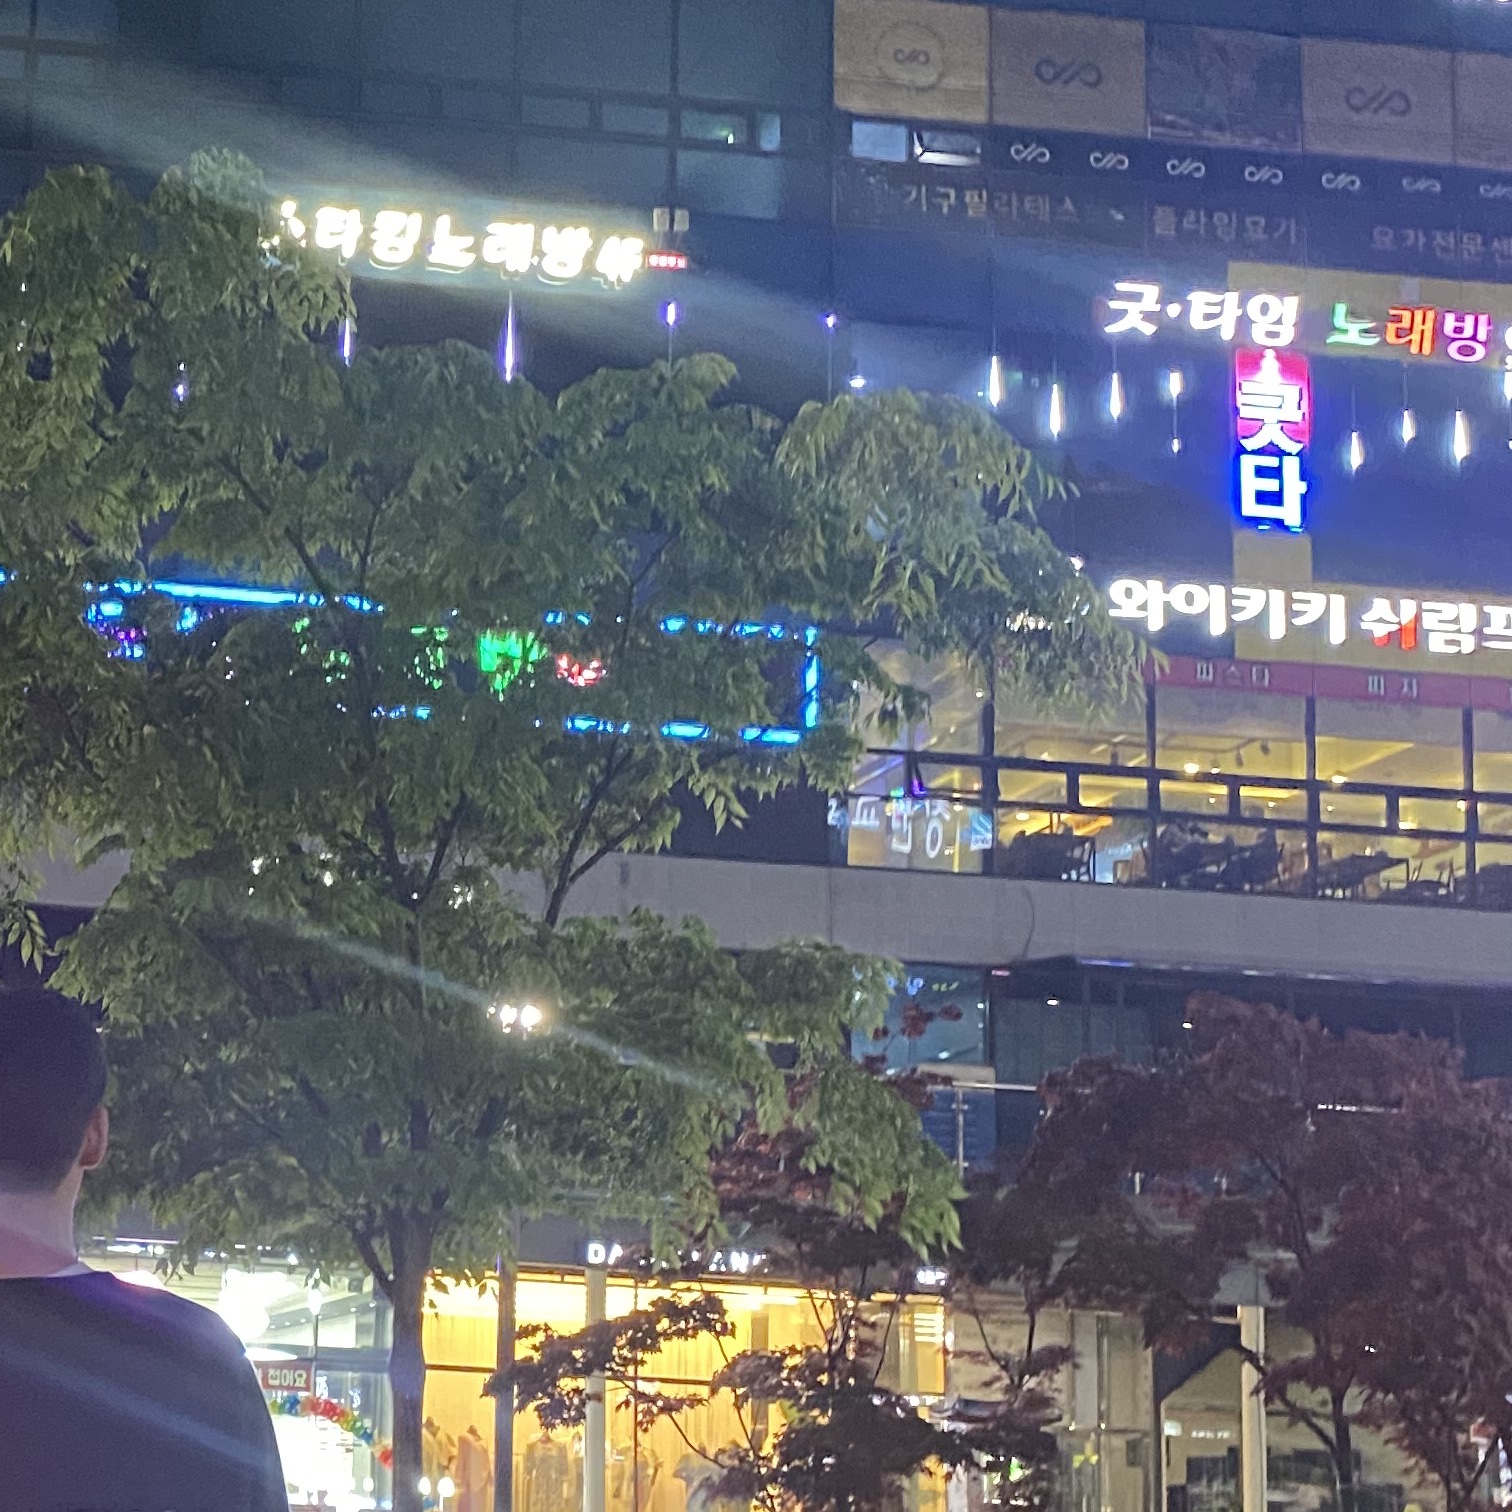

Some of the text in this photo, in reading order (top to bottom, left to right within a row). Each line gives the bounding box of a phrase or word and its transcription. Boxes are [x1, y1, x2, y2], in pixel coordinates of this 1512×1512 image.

[262, 200, 591, 280] 타킹노래방
[1326, 300, 1492, 363] 노래방
[1107, 577, 1349, 646] 와이키키
[1194, 662, 1272, 689] 파스타
[1367, 674, 1419, 699] 피자
